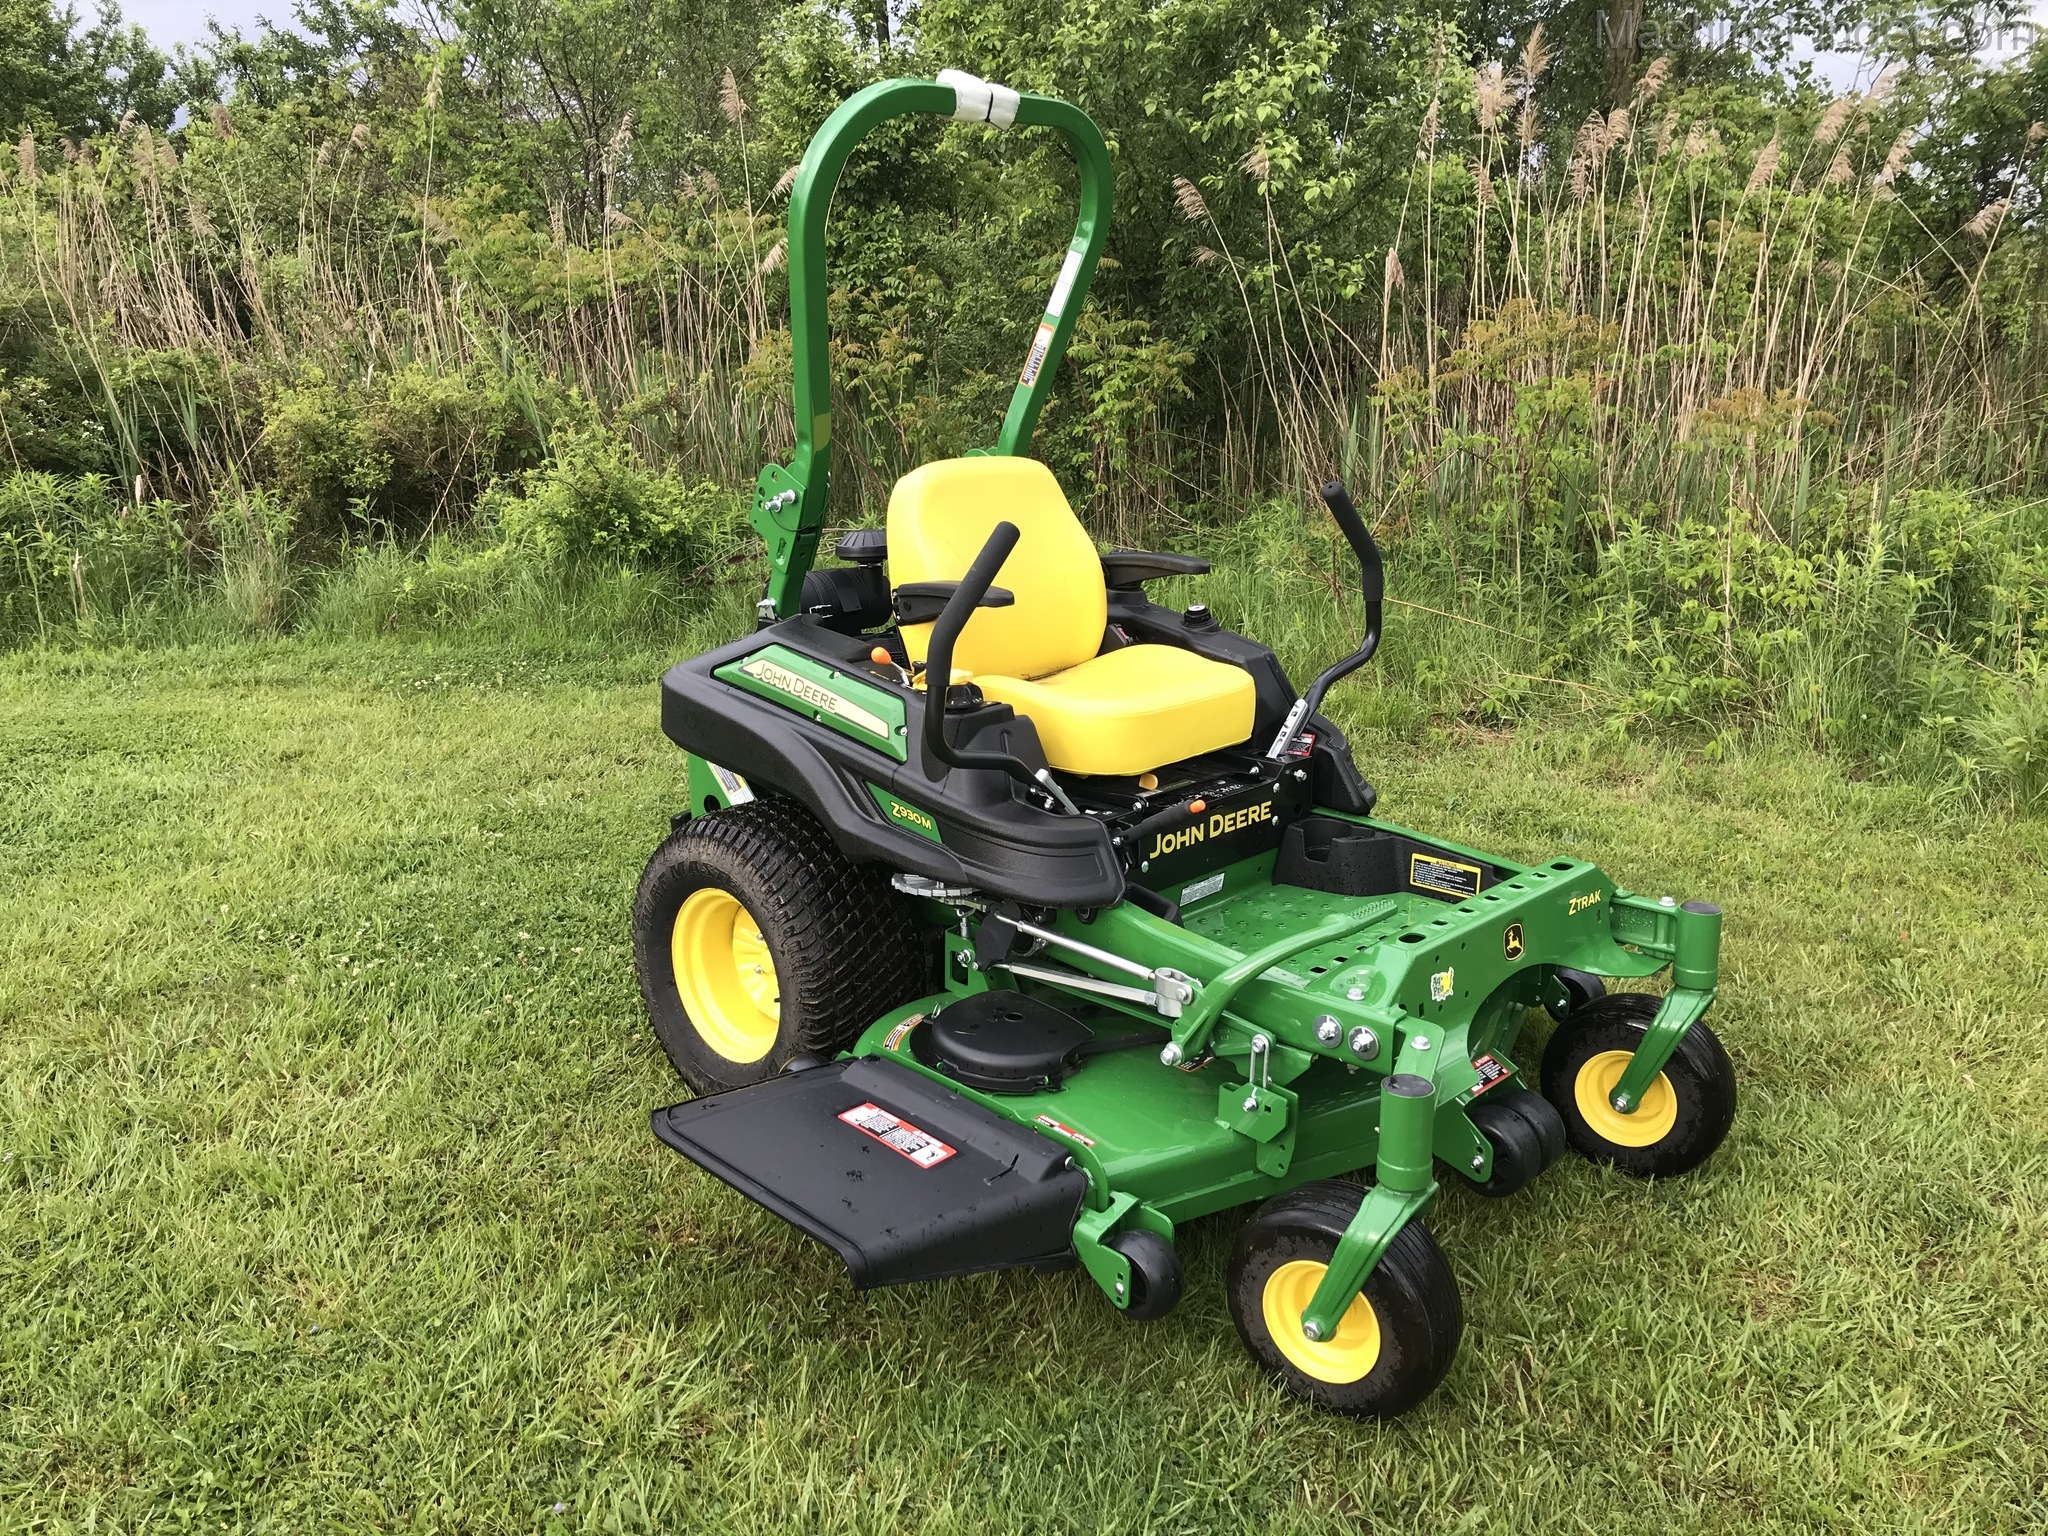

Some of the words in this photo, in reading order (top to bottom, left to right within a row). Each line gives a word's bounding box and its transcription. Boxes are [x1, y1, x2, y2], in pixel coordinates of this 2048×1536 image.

[756, 662, 792, 690] JOHN
[793, 677, 838, 711] DEERE
[890, 801, 932, 831] Z930M
[1149, 823, 1205, 860] JOHN
[1209, 800, 1272, 839] DEERE
[669, 860, 753, 906] MASTER
[1568, 889, 1602, 916] ZTRAK
